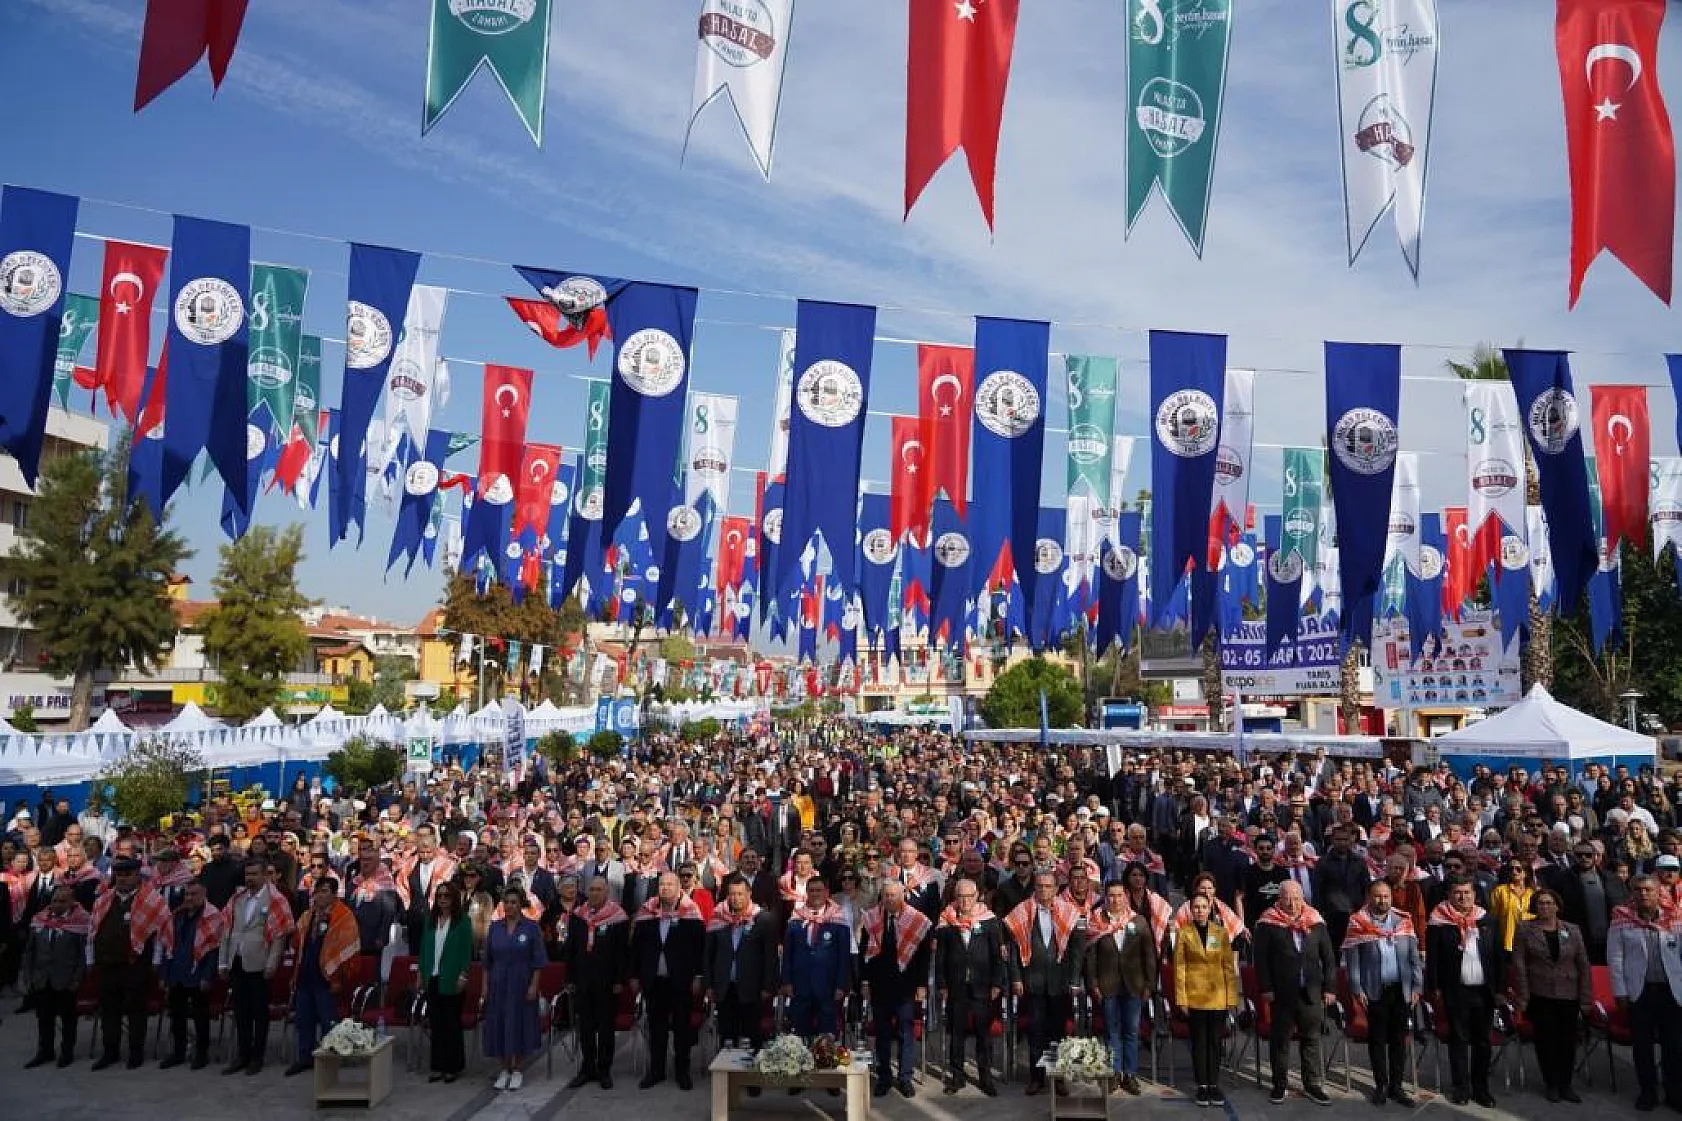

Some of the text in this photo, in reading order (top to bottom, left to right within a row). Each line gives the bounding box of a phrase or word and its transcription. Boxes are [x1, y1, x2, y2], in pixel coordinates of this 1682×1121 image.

[712, 14, 758, 50] HASAT
[1346, 2, 1382, 66] 8
[252, 292, 268, 331] 8
[590, 401, 604, 430] 8
[695, 404, 709, 433] 8
[1471, 408, 1485, 444] 8
